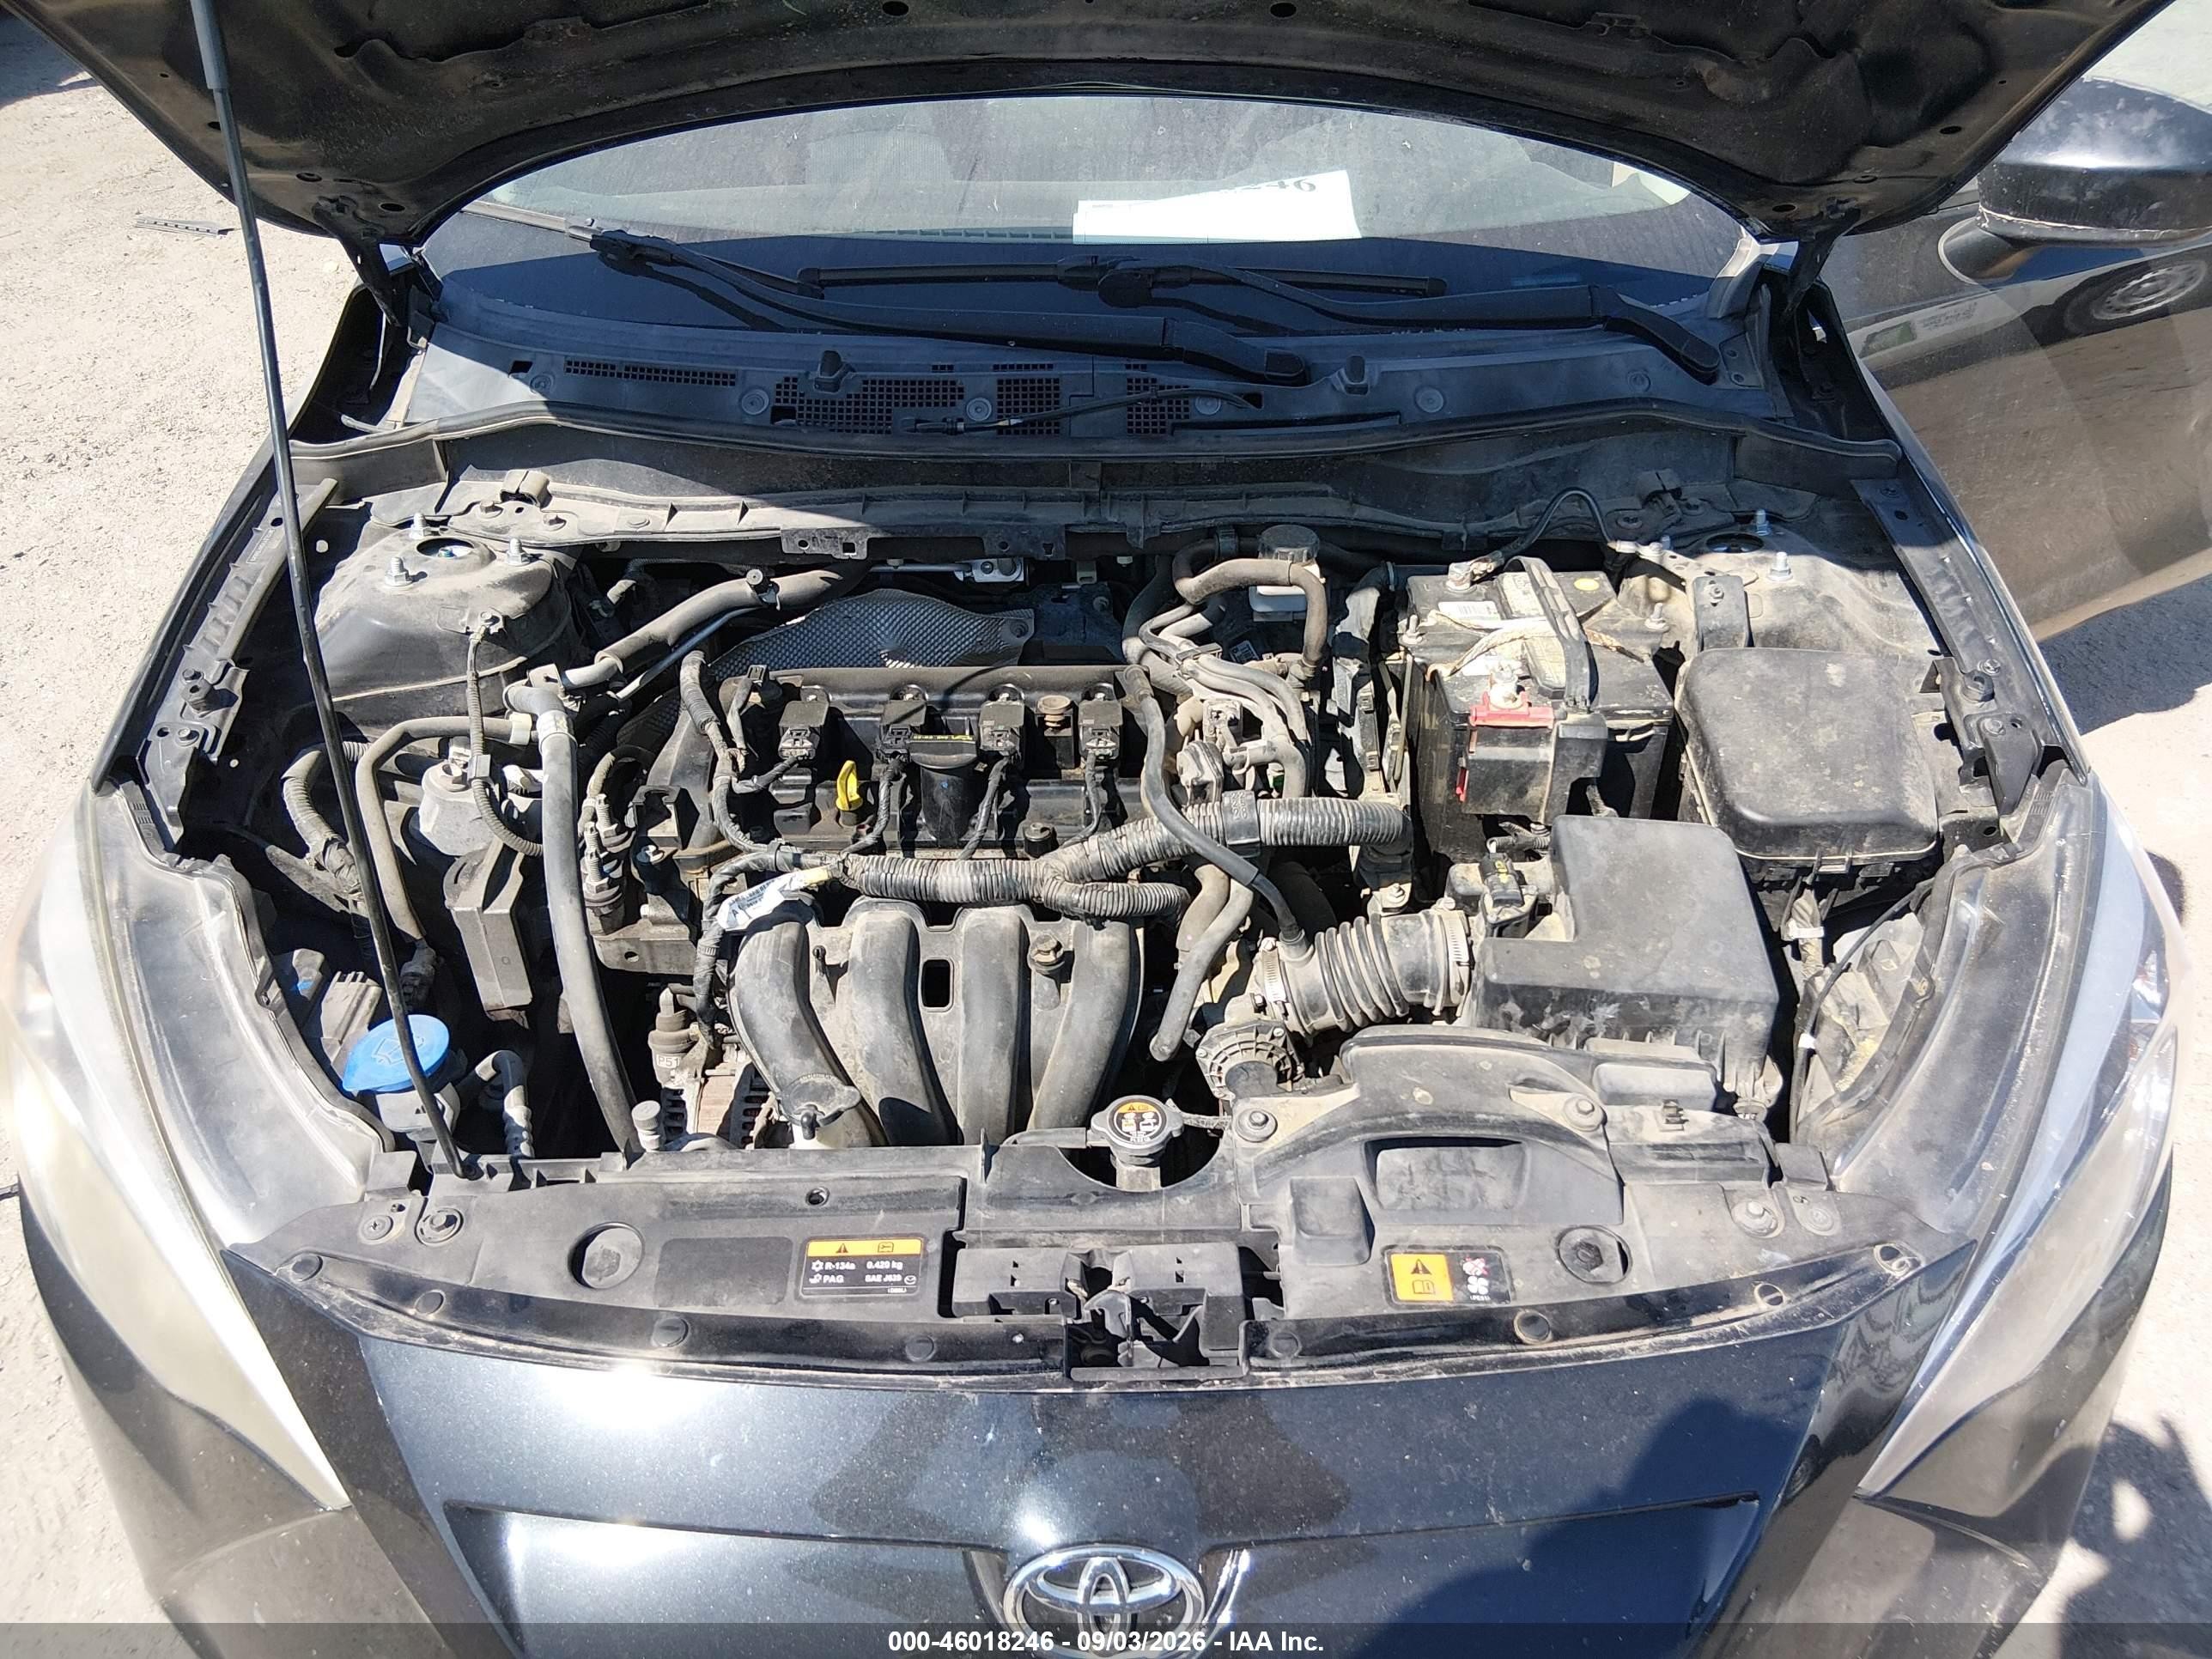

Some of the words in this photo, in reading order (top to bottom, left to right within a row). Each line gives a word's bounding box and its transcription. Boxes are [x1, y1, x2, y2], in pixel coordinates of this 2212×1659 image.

[825, 1261, 855, 1270] R-134a
[891, 1261, 902, 1271] kg
[823, 1274, 844, 1283] PAG
